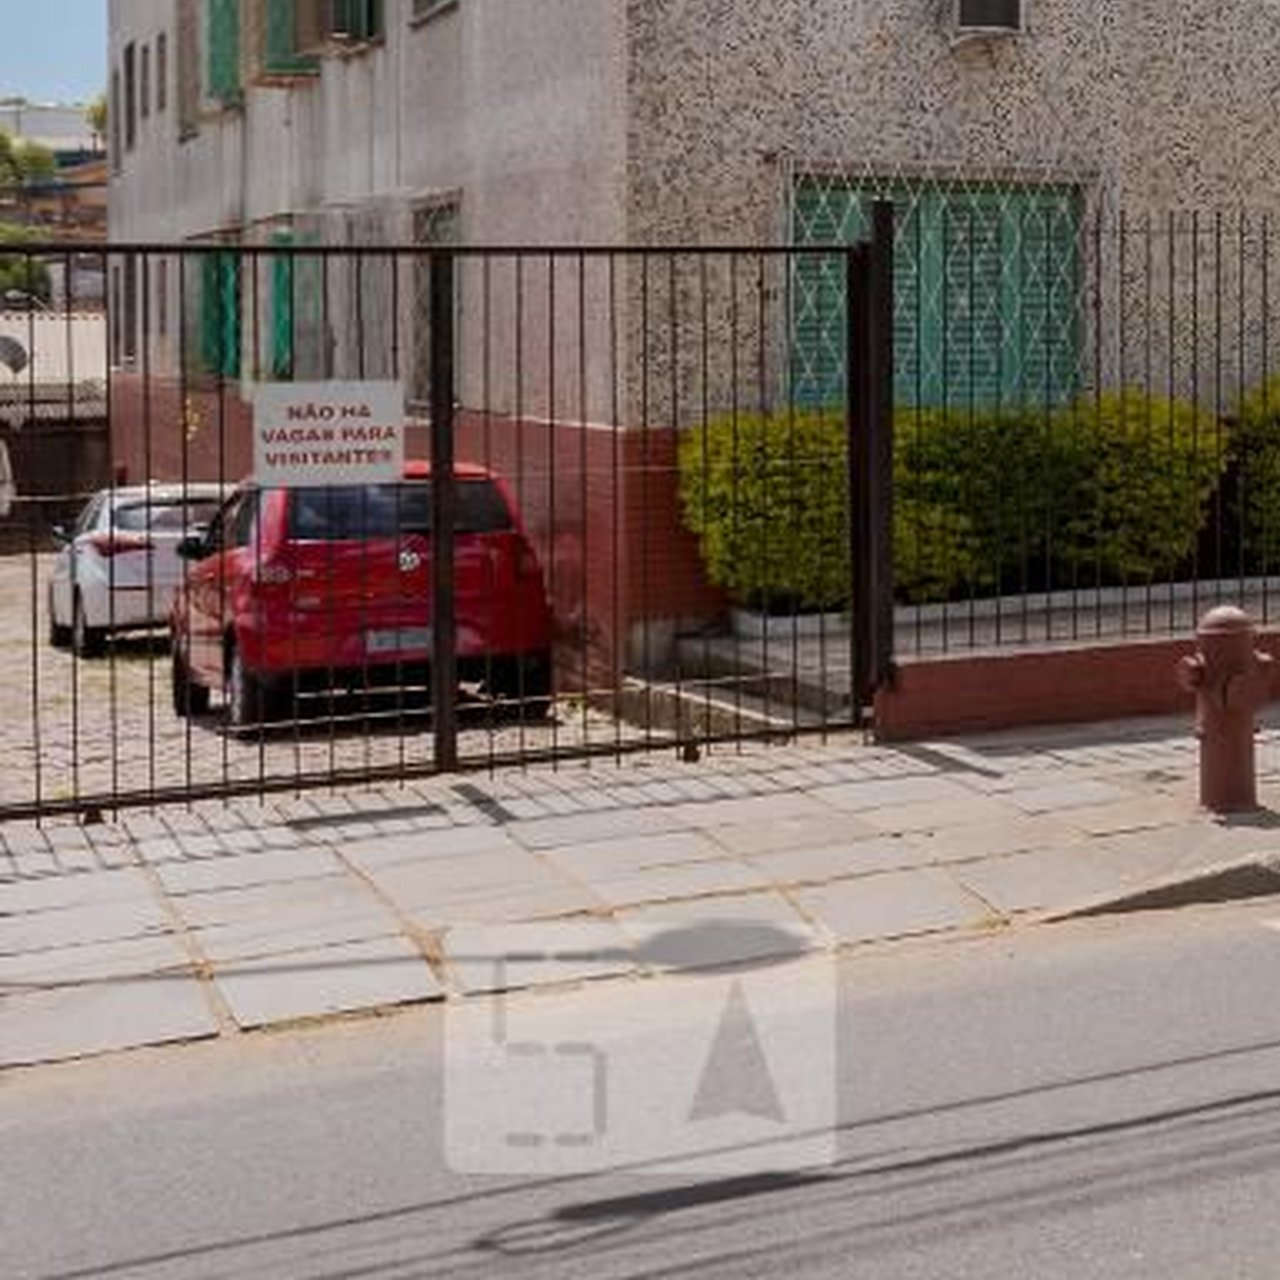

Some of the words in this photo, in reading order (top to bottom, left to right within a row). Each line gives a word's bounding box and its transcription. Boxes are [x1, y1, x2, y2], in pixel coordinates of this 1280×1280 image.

[287, 403, 335, 420] NÃO
[262, 428, 334, 444] VAGAS
[342, 426, 396, 442] PARA
[265, 449, 393, 466] VISITANTES
